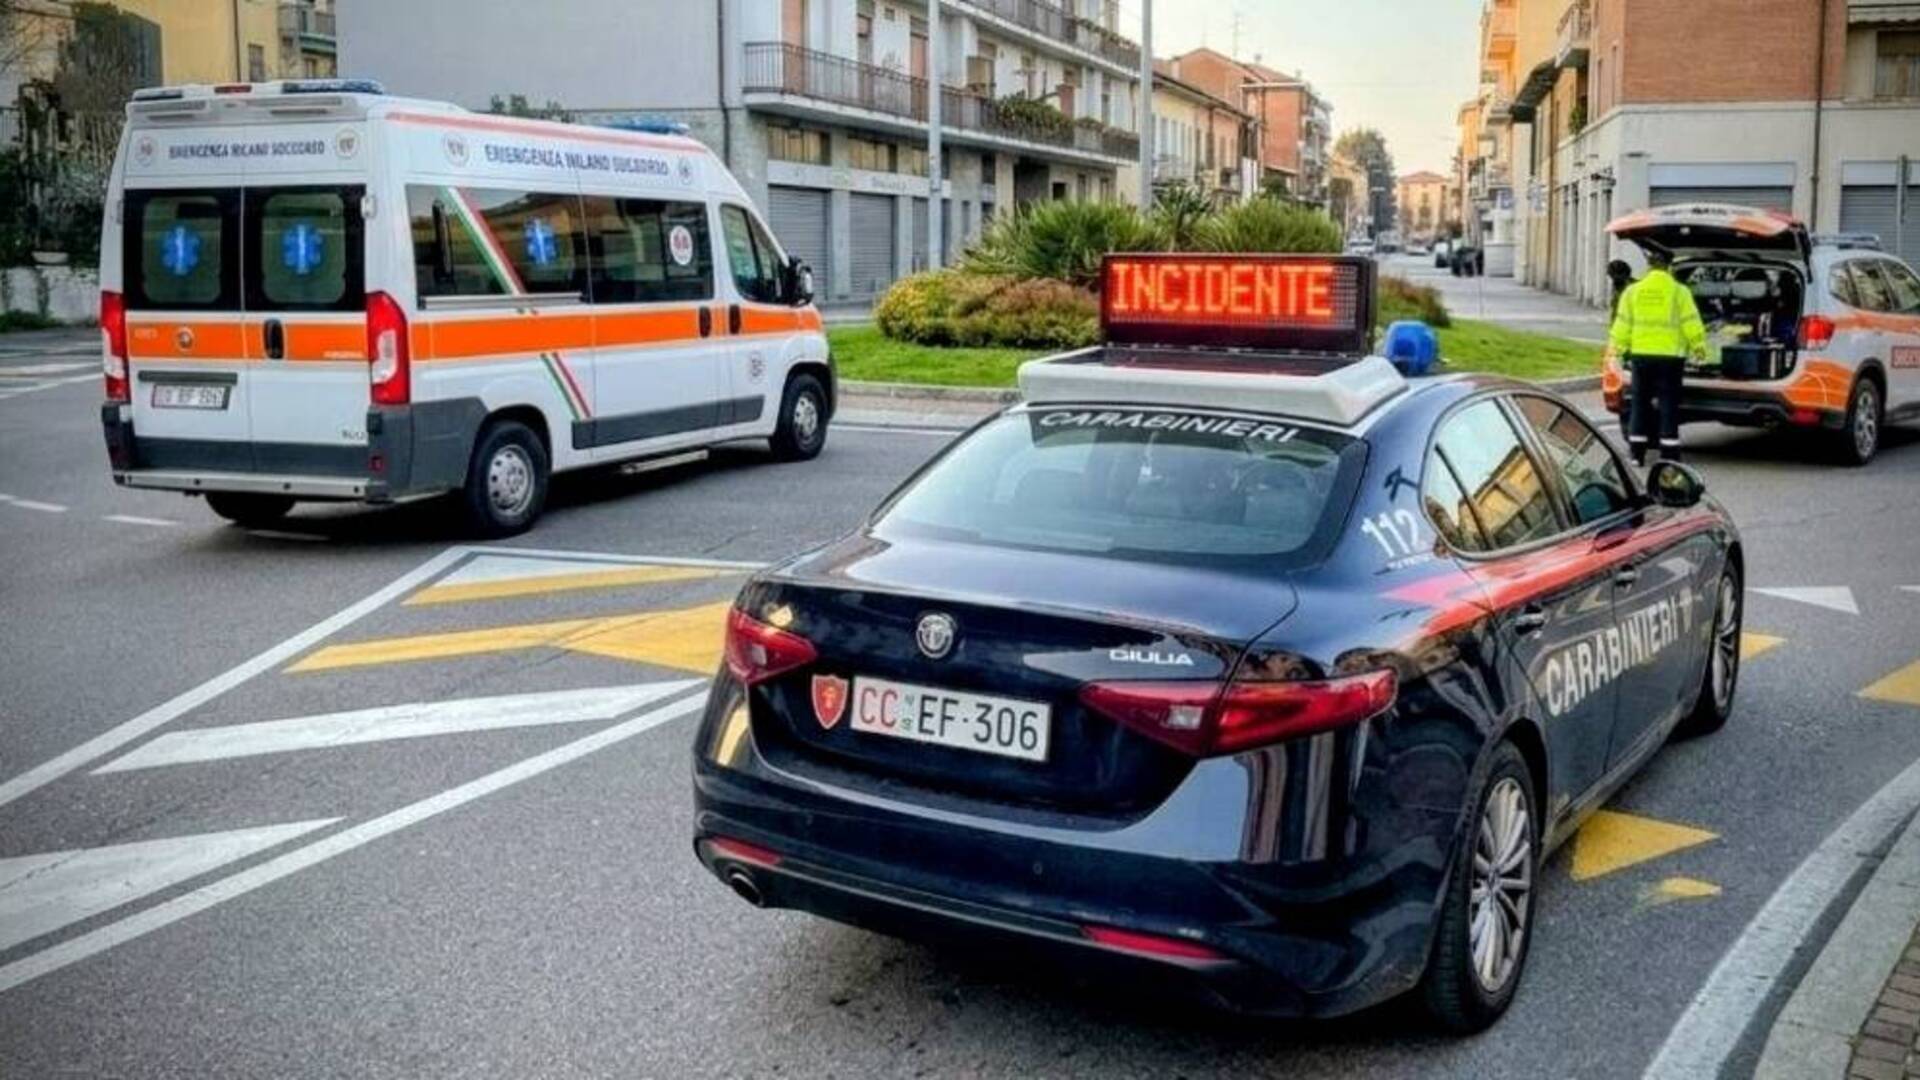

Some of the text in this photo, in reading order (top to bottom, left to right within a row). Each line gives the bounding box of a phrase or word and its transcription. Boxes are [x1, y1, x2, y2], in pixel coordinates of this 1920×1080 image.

[1111, 263, 1333, 317] INCIDENTE
[1039, 411, 1299, 444] CARABINIERI
[1361, 508, 1419, 558] 112
[1109, 648, 1196, 666] GIULIA
[1545, 594, 1679, 717] CARABINIERI
[859, 686, 898, 729] CC
